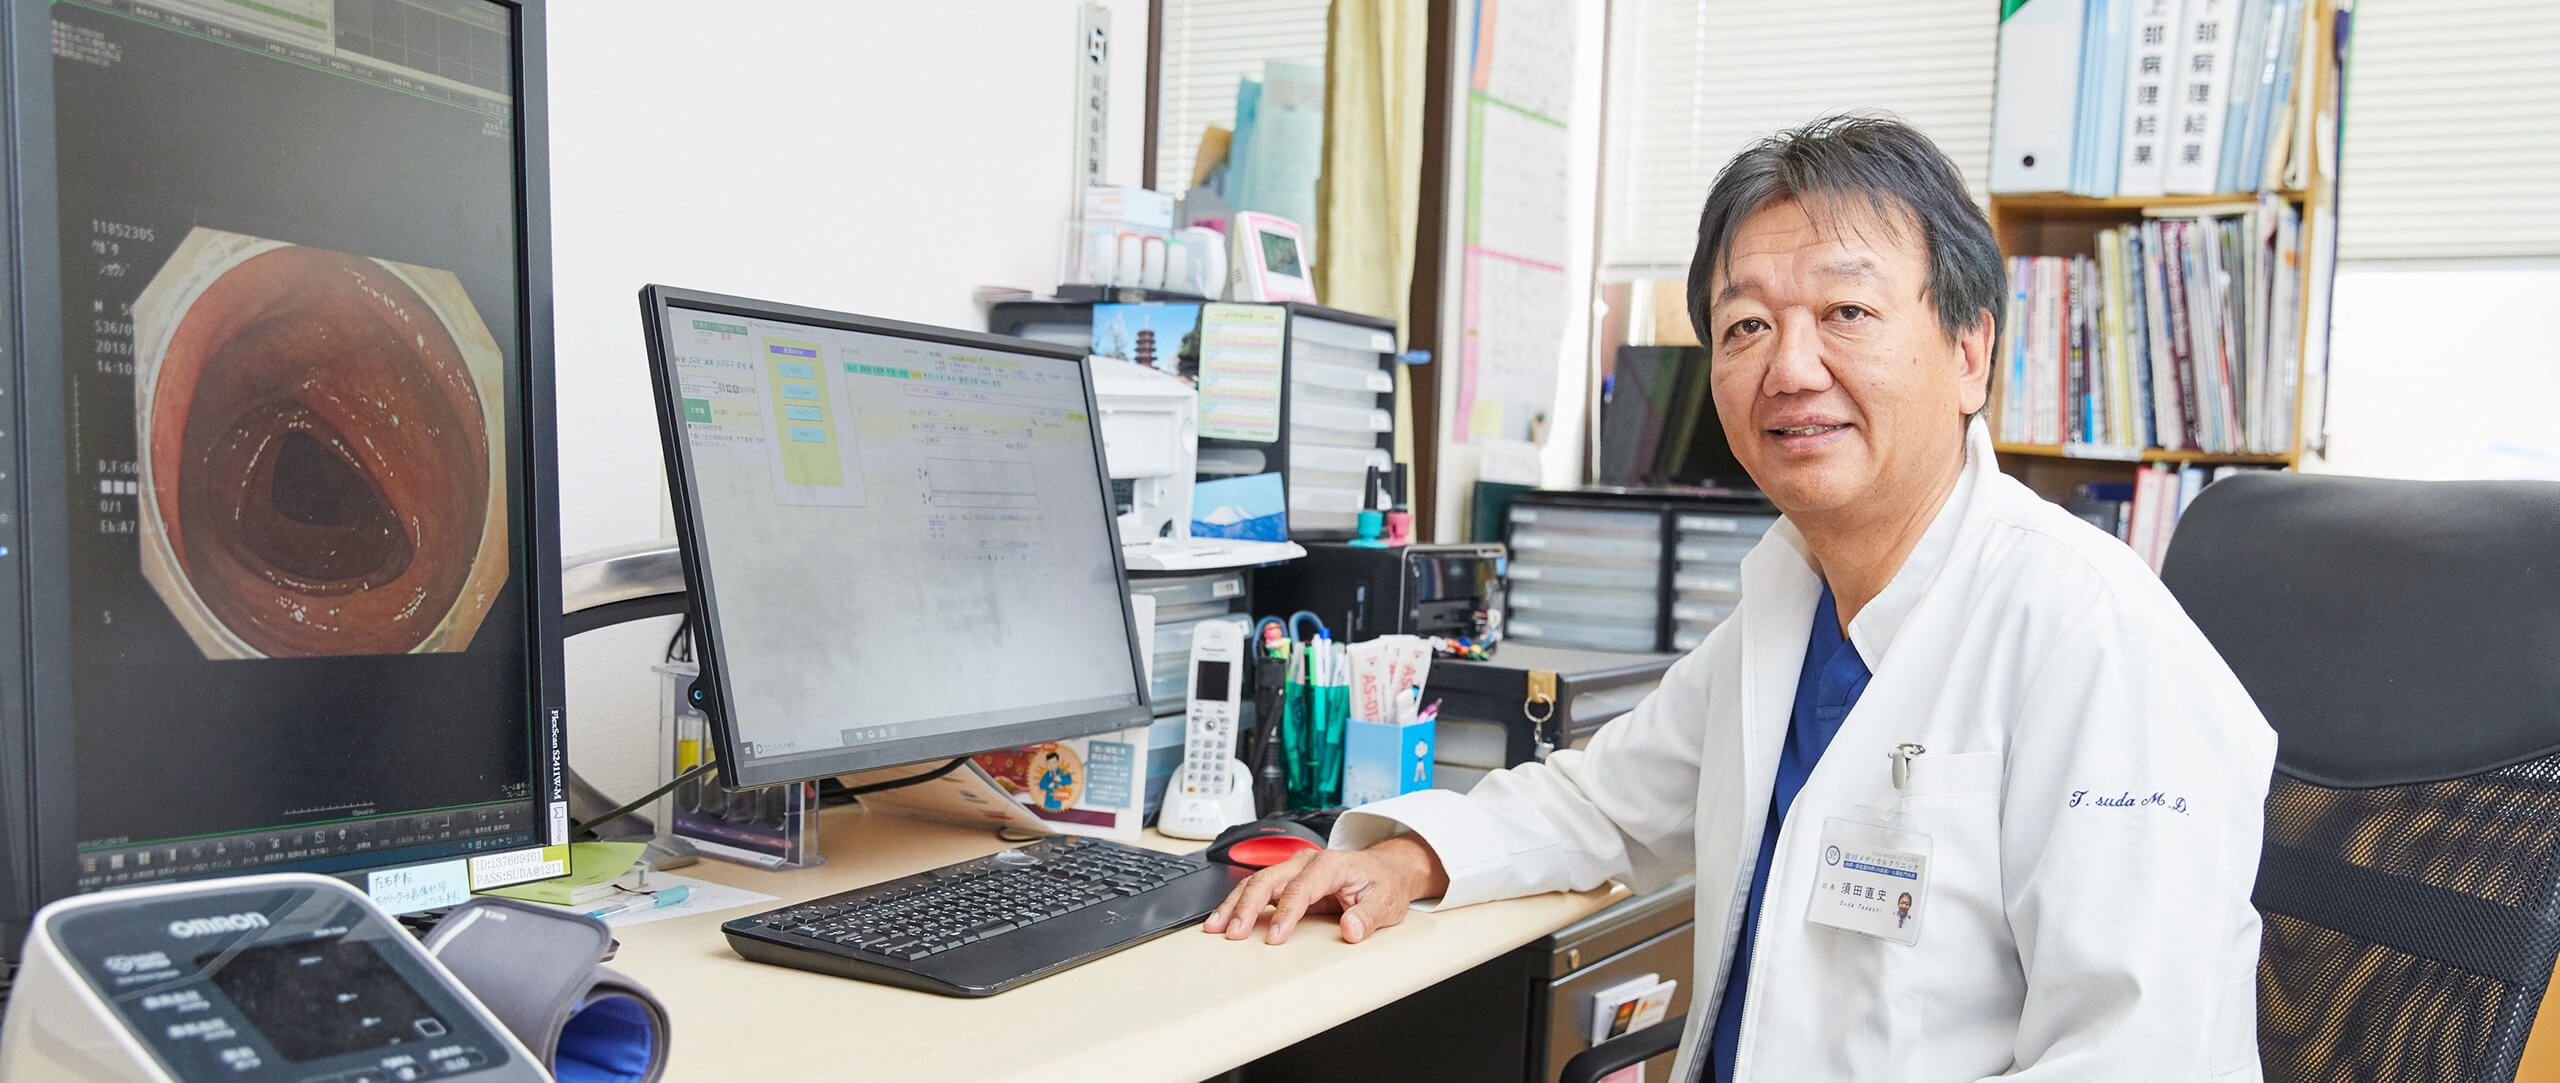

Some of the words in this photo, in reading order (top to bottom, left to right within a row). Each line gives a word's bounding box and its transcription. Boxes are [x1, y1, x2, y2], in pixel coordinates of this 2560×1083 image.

[92, 219, 155, 242] 11852305
[551, 709, 561, 749] FlexScan
[2095, 791, 2136, 807] suda
[1840, 882, 1887, 902] 須田直史
